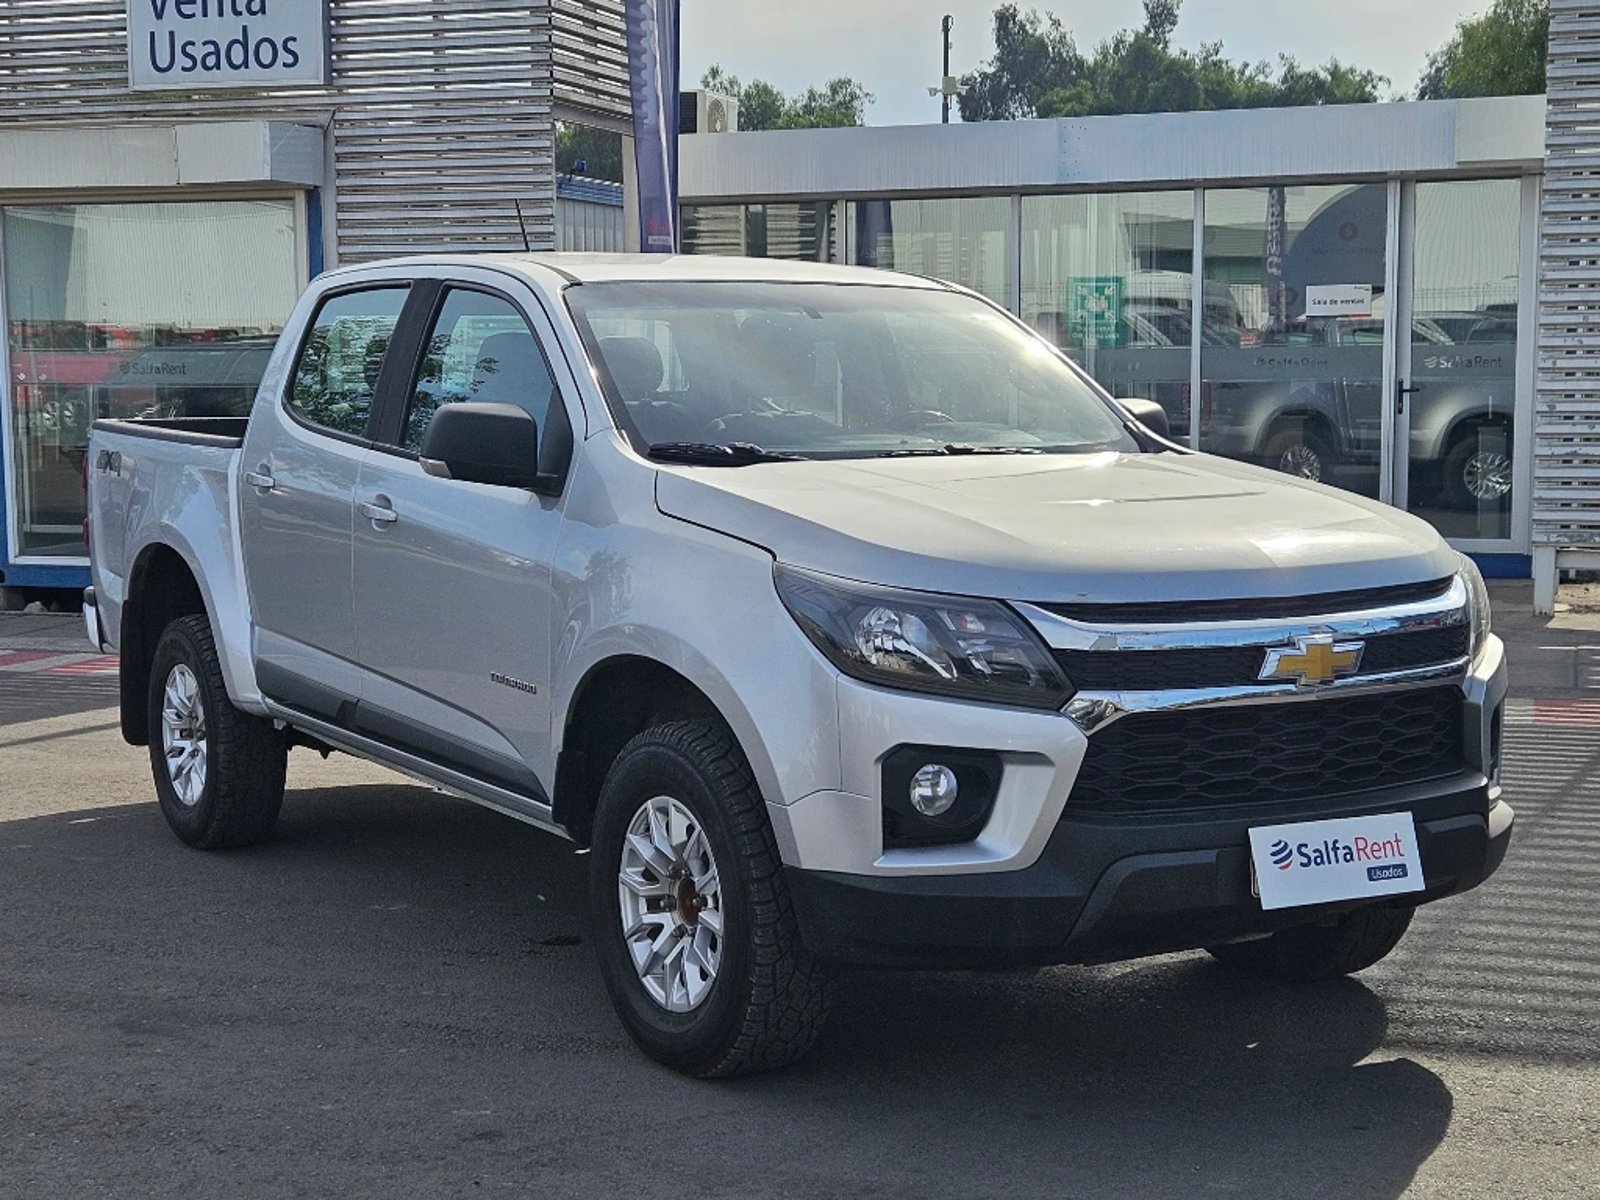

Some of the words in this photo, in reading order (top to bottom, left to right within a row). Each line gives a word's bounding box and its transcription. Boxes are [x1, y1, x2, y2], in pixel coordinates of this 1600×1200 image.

[149, 25, 299, 73] Usados
[1329, 297, 1338, 305] de
[1296, 833, 1405, 869] SalfaRent
[1371, 867, 1404, 879] Usados
